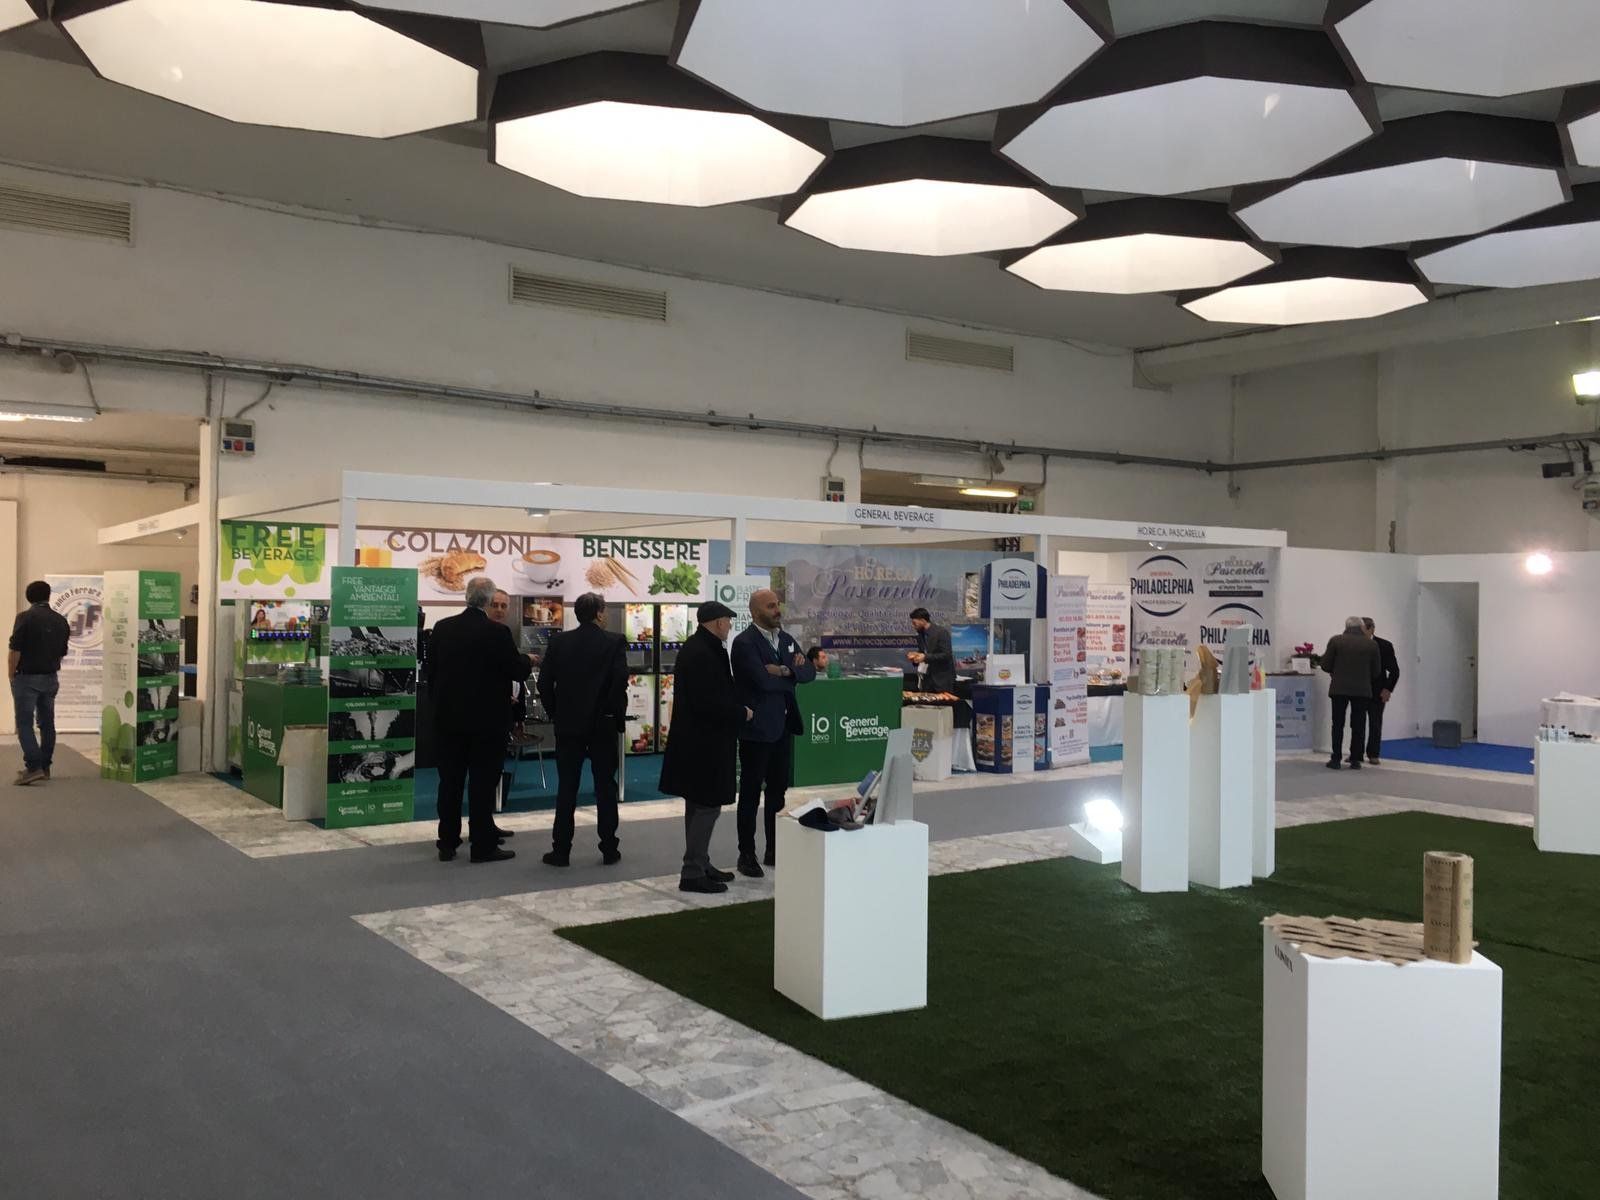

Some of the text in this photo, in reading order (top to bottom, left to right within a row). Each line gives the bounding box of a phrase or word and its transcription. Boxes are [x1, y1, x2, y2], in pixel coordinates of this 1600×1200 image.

[854, 508, 935, 523] GENERAL BEVERAGE
[231, 524, 316, 548] FREE
[1169, 528, 1207, 538] PASCARELLA
[387, 530, 531, 555] COLAZIONI
[582, 537, 701, 560] BENESSERE
[231, 548, 316, 561] BEVERAGE
[1207, 561, 1266, 576] Pascarella
[342, 576, 364, 585] FREE
[814, 573, 937, 601] Pascarella
[998, 578, 1031, 589] PHILADELPHIA
[1130, 577, 1195, 596] PHILADELPHIA
[353, 584, 397, 593] VANTAGGI
[350, 592, 400, 601] AMBIENTALI
[1138, 631, 1189, 646] Pascarella
[839, 715, 879, 730] General
[845, 725, 889, 739] Beverage
